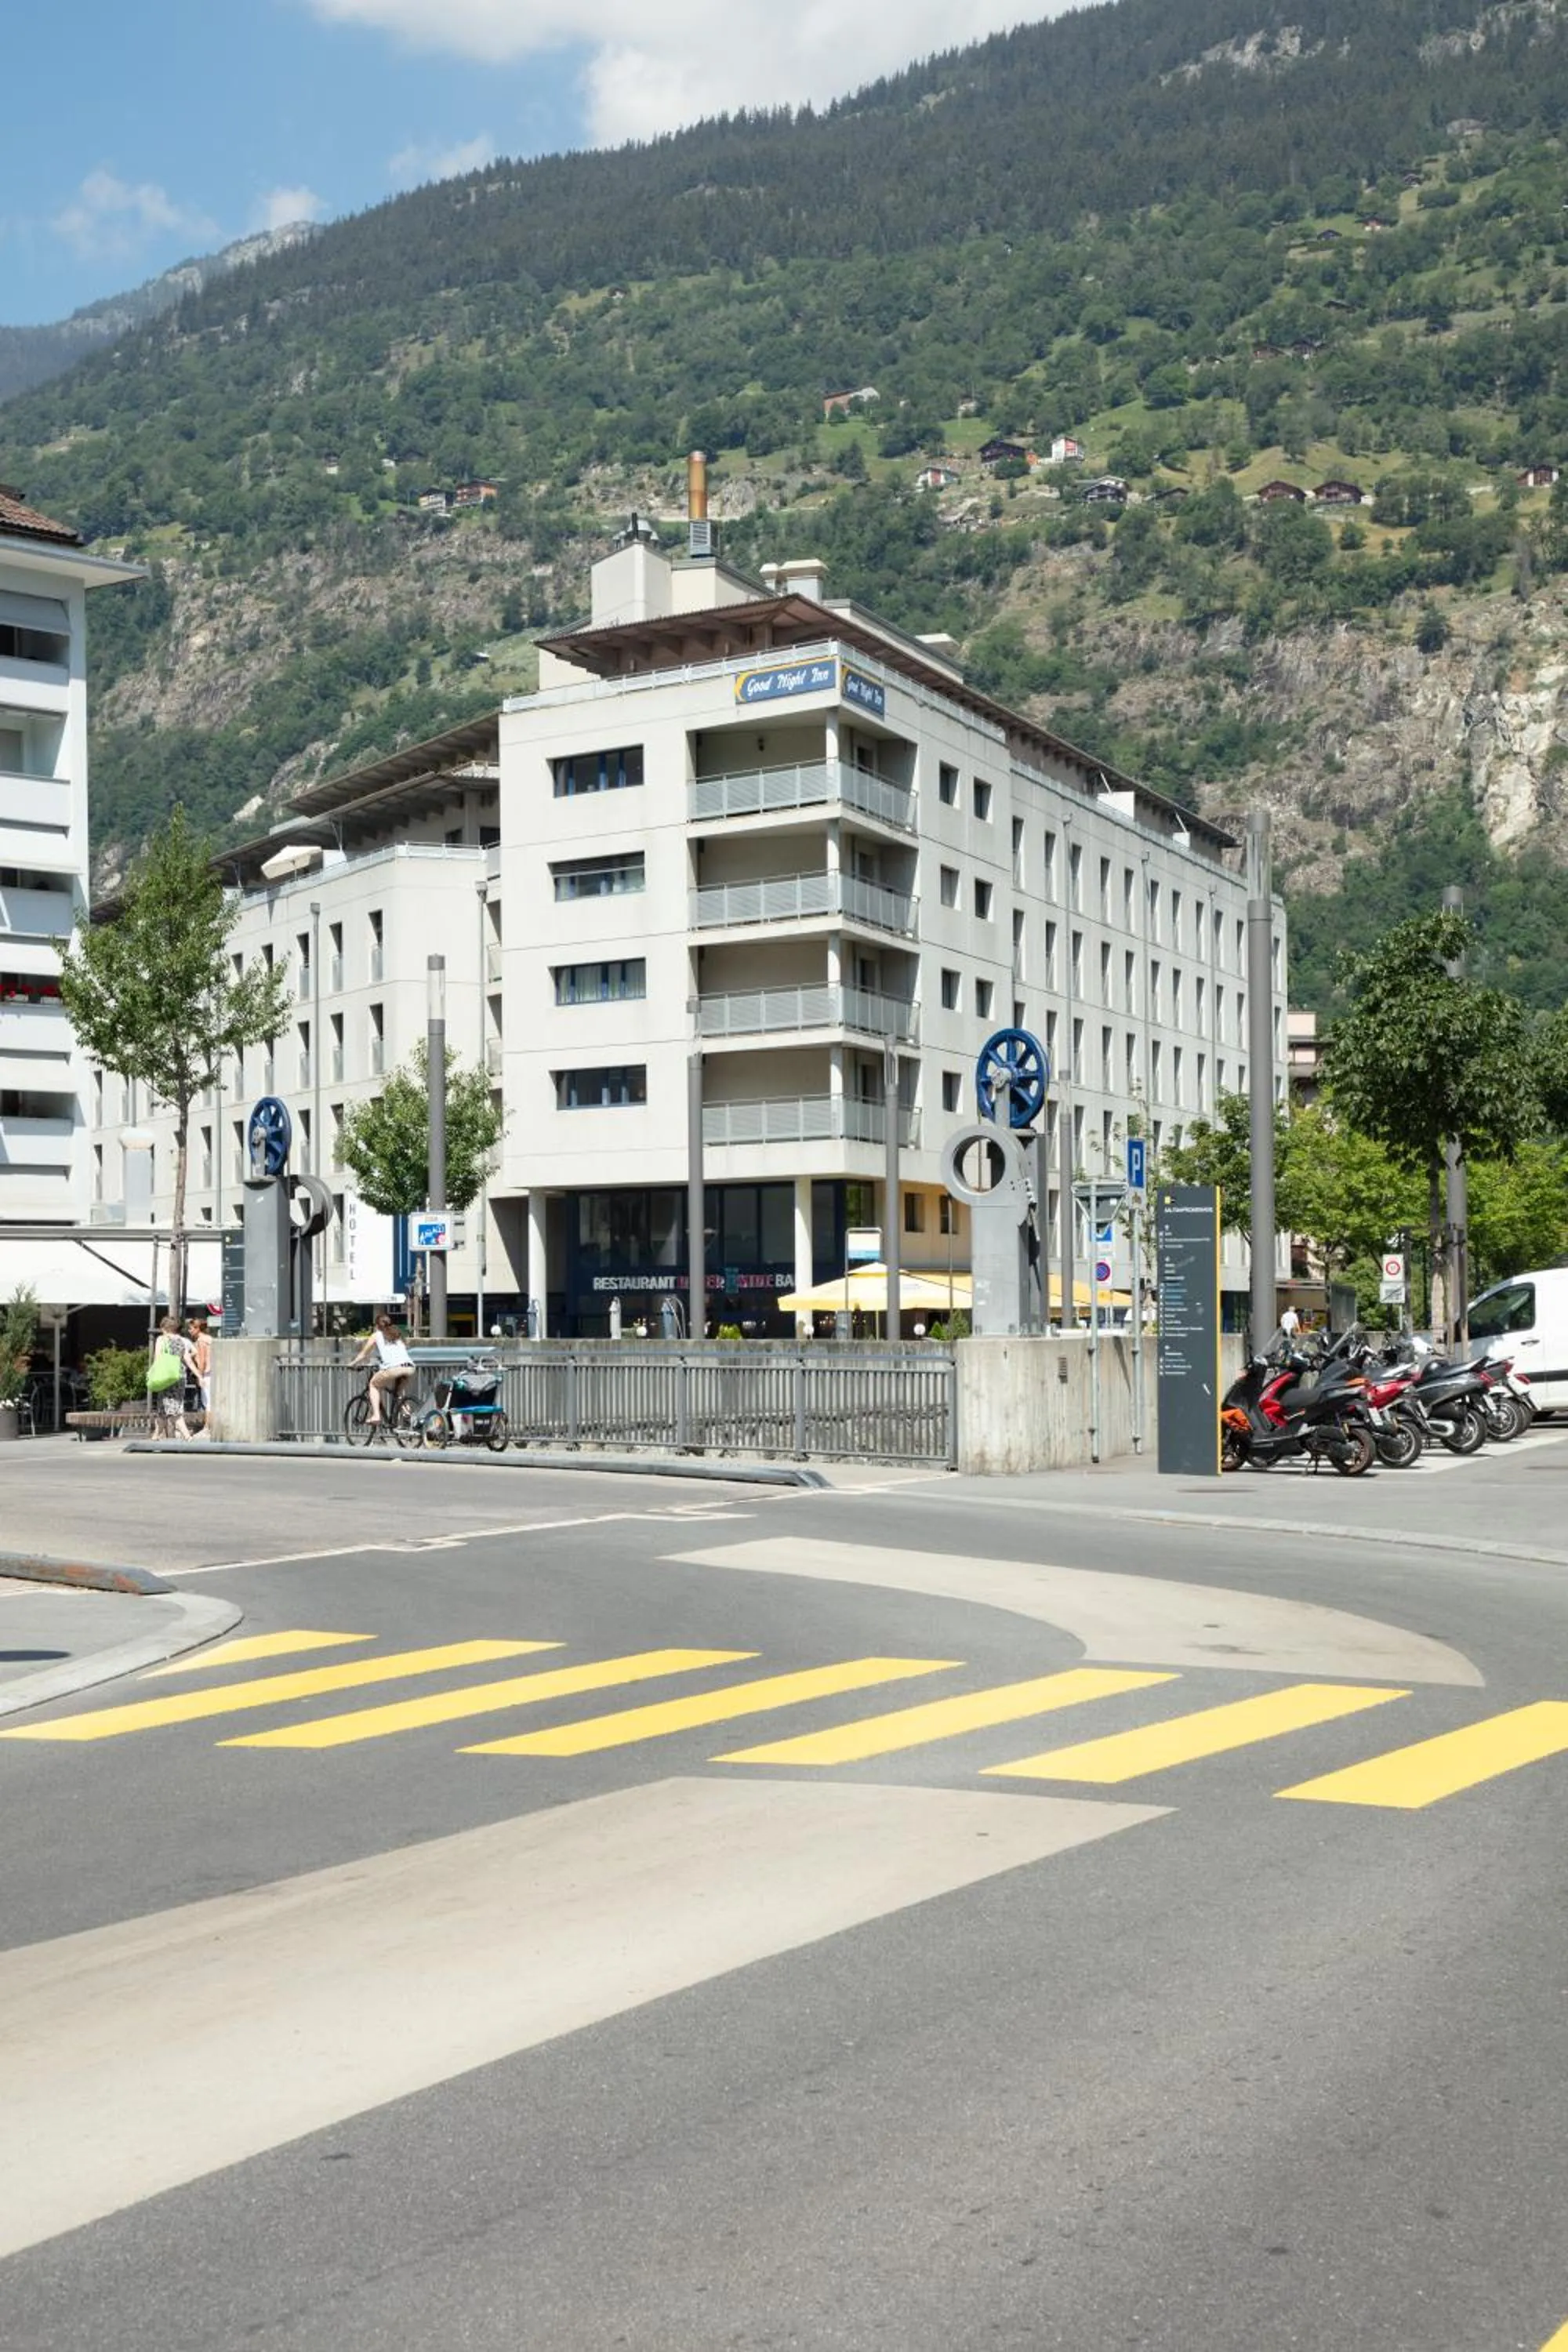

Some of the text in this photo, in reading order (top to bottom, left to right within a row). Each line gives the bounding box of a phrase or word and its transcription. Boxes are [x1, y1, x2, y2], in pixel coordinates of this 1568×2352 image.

[747, 667, 829, 696] Good Night Inn
[847, 675, 859, 694] Good
[1131, 1148, 1141, 1182] P
[593, 1276, 676, 1290] RESTAURANT
